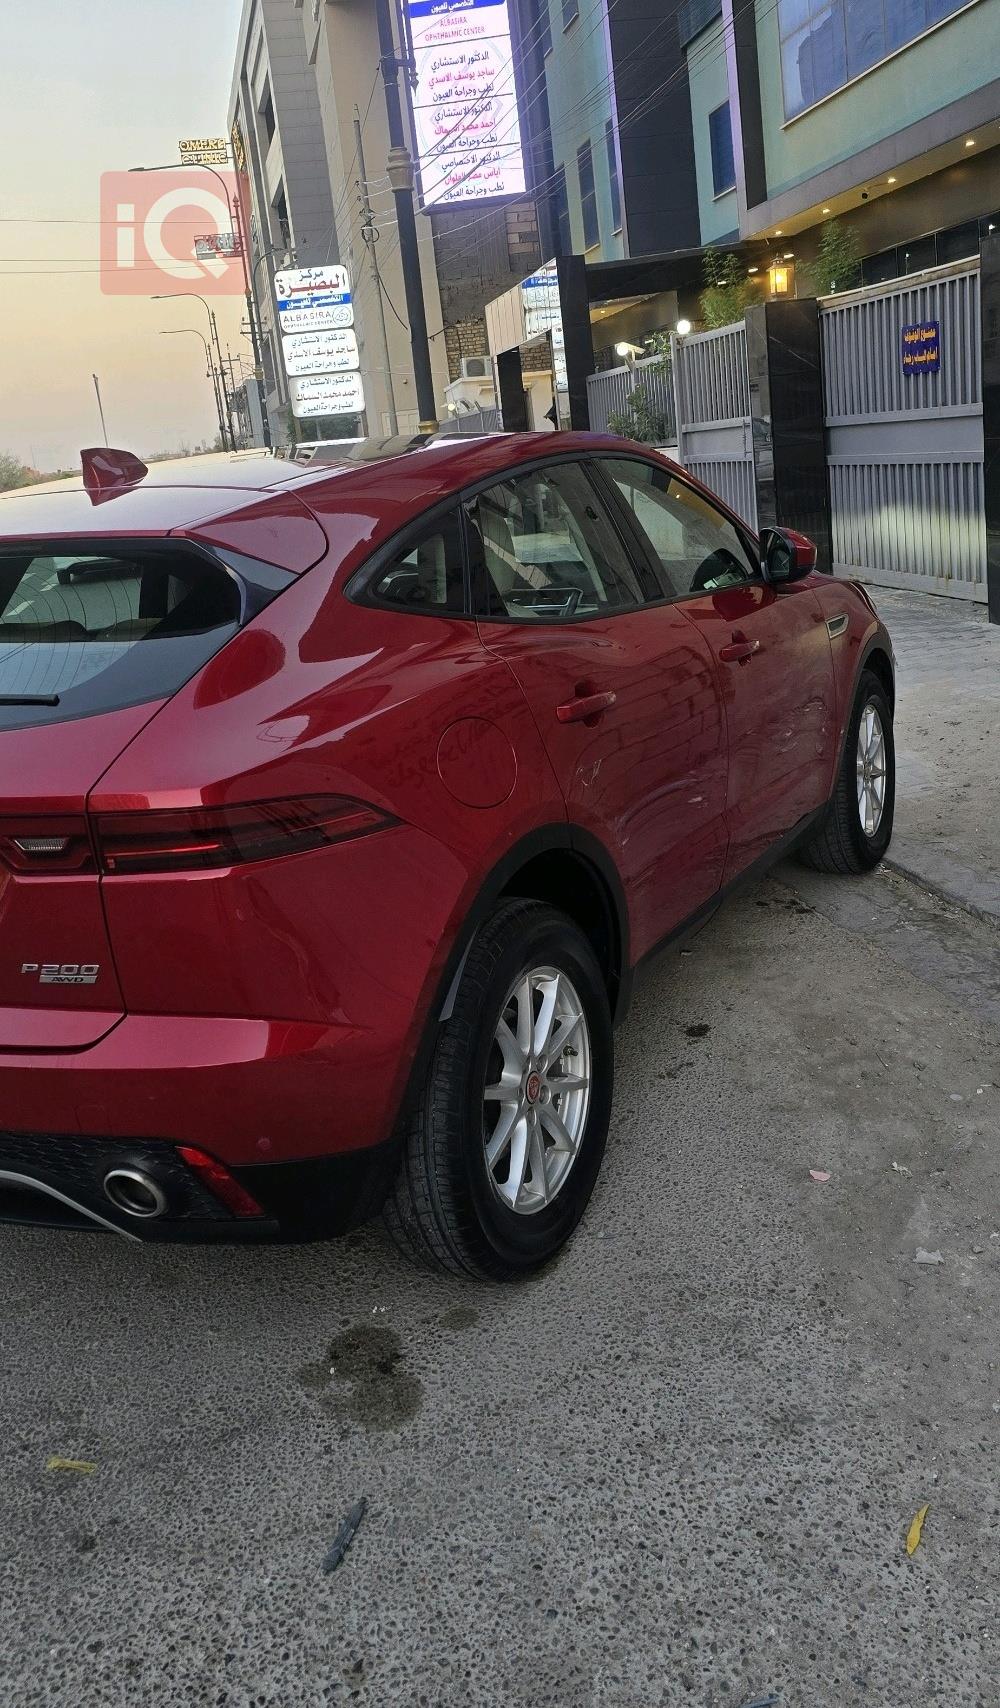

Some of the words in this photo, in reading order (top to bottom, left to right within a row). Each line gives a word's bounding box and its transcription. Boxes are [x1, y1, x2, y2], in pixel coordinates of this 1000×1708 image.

[440, 17, 467, 27] ALBASIRA
[425, 29, 462, 41] OPHTHALMIC
[463, 26, 485, 36] CENTER
[468, 51, 489, 65] الدكتور
[431, 55, 466, 73] الاستشاري
[454, 71, 475, 81] يوسف
[477, 68, 494, 78] ساجد
[428, 73, 451, 89] الاسدي
[432, 88, 452, 102] العيون
[455, 86, 476, 97] وجراحة
[435, 106, 470, 124] الاستشاري
[481, 119, 495, 128] احمد
[458, 137, 479, 148] وجراحة
[482, 133, 497, 143] لطب
[466, 185, 487, 196] وجراحة
[489, 182, 504, 192] لطب
[444, 188, 464, 200] العيون
[299, 269, 323, 281] مركز
[276, 273, 345, 298] البصيرة
[284, 311, 331, 322] ALBASIRA
[292, 335, 322, 348] الاستشاري
[325, 333, 347, 343] الدكتور
[904, 328, 920, 344] الوقوف
[313, 347, 334, 356] يوسف
[336, 345, 355, 353] ساجد
[288, 348, 311, 362] الاسدي
[295, 362, 314, 371] العيون
[300, 377, 331, 390] الاستشاري
[332, 375, 353, 386] الدكتور
[323, 391, 342, 399] محمد
[342, 388, 359, 397] احمد
[21, 963, 100, 975] P200
